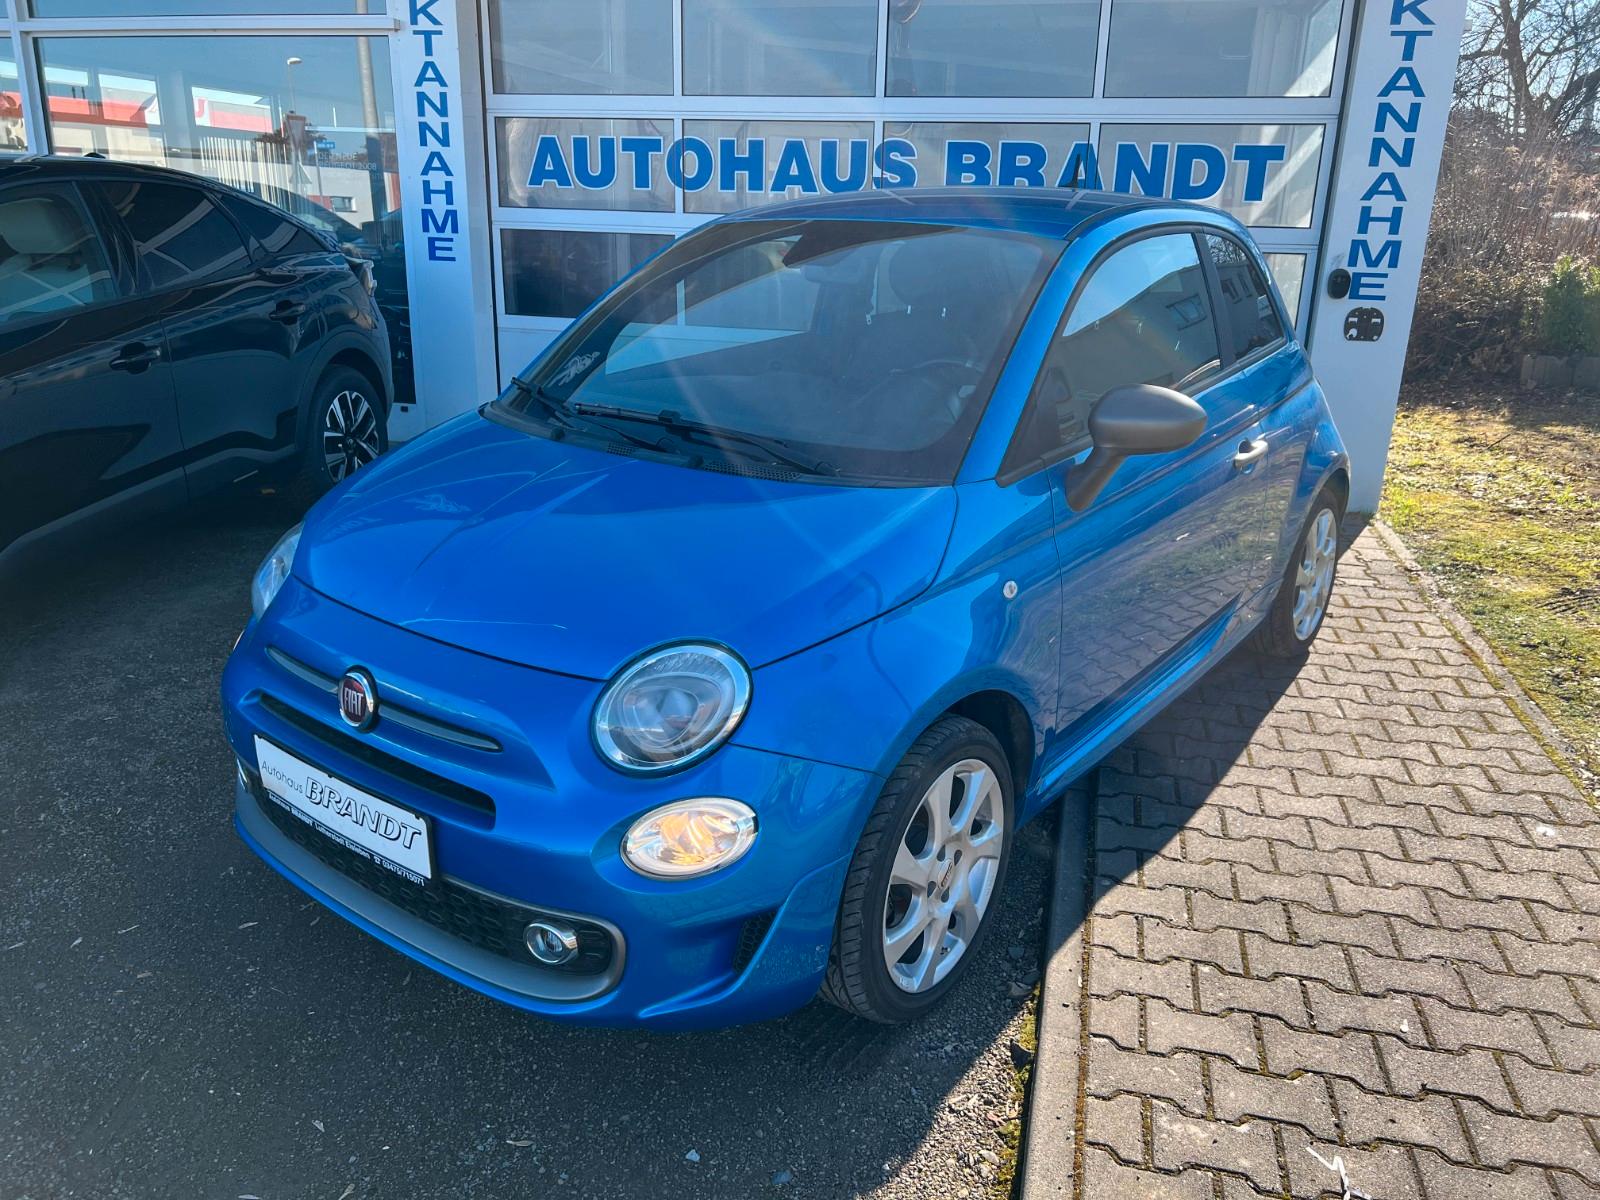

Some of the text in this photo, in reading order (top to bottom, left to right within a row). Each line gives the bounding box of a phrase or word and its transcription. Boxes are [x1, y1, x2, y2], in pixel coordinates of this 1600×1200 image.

[527, 134, 1286, 202] AUTOHAUS BRANDT
[344, 687, 364, 716] FIAT
[261, 760, 422, 850] Autohaus BRANDT
